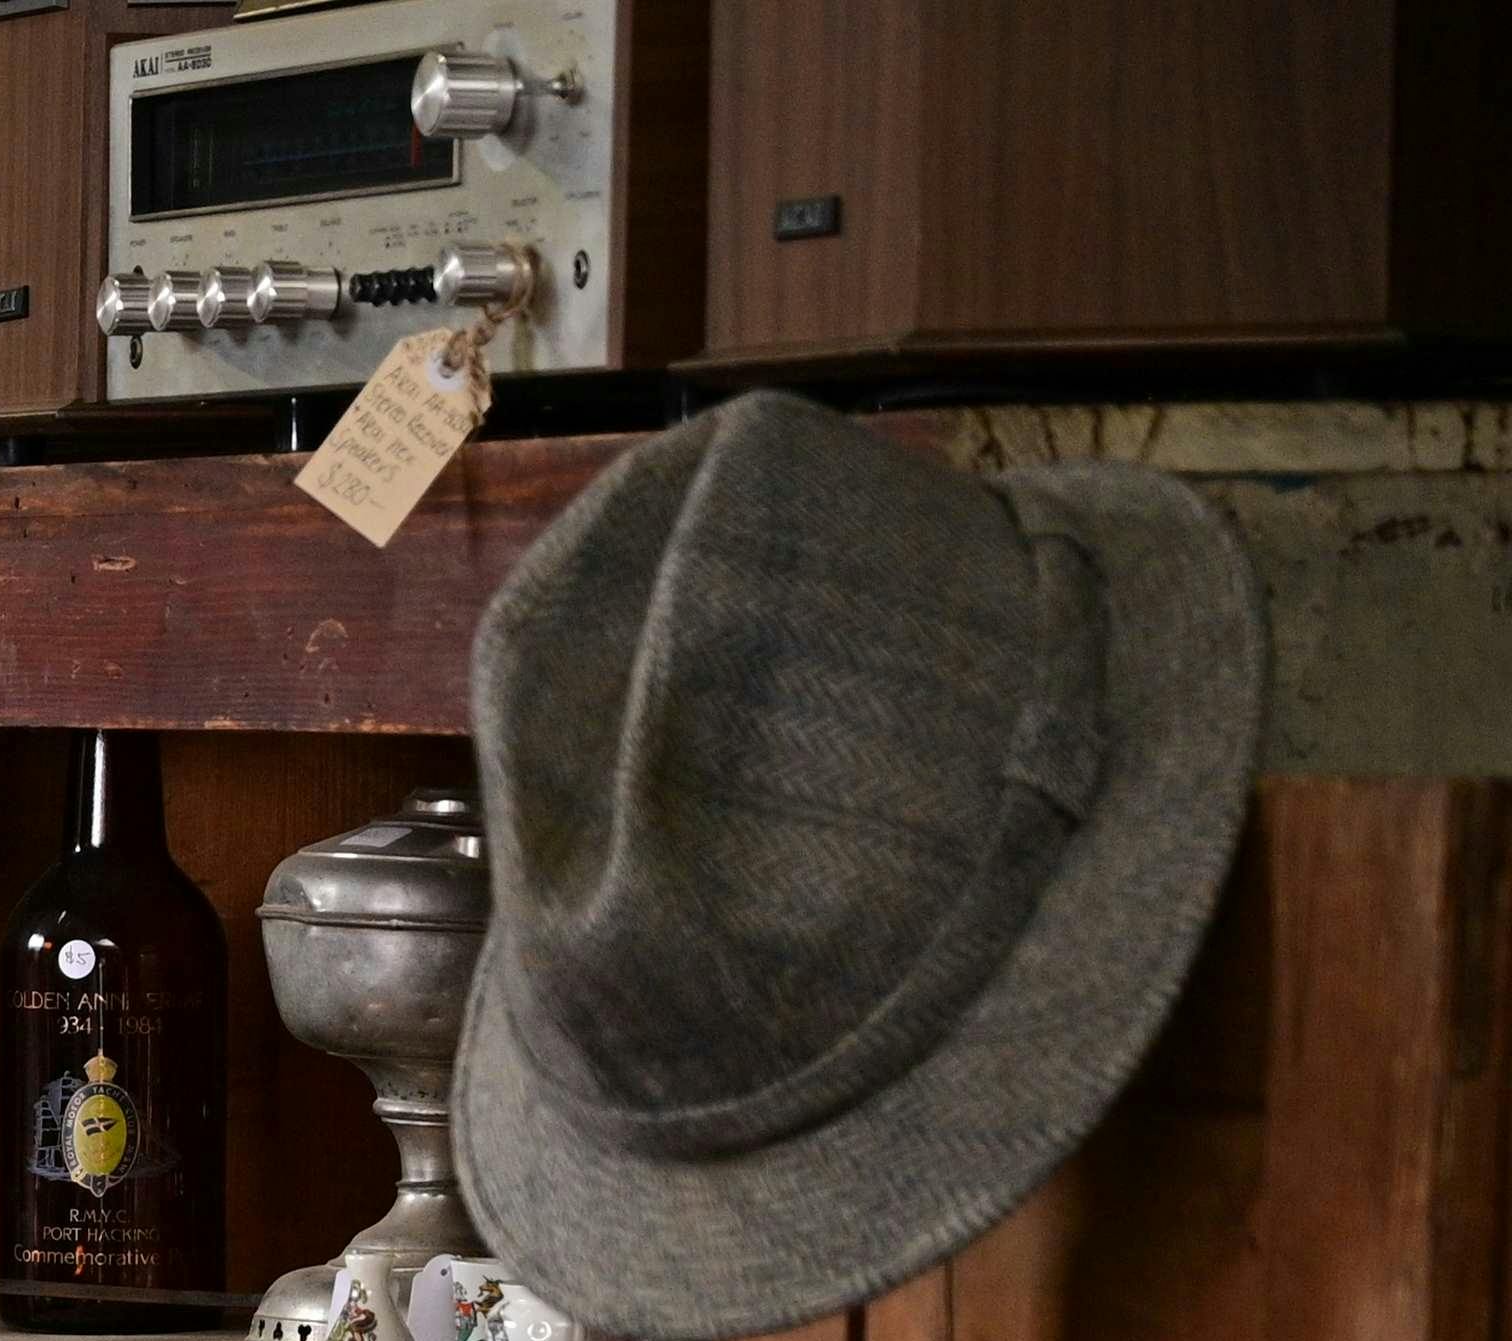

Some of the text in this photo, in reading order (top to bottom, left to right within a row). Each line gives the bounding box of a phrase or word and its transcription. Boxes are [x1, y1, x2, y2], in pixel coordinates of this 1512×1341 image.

[134, 56, 159, 78] AKAI
[65, 945, 92, 966] $5
[57, 1015, 93, 1035] 934
[66, 1091, 86, 1128] MOTOR
[42, 1226, 161, 1243] PORT HACKING
[14, 1243, 161, 1266] Commemorative
